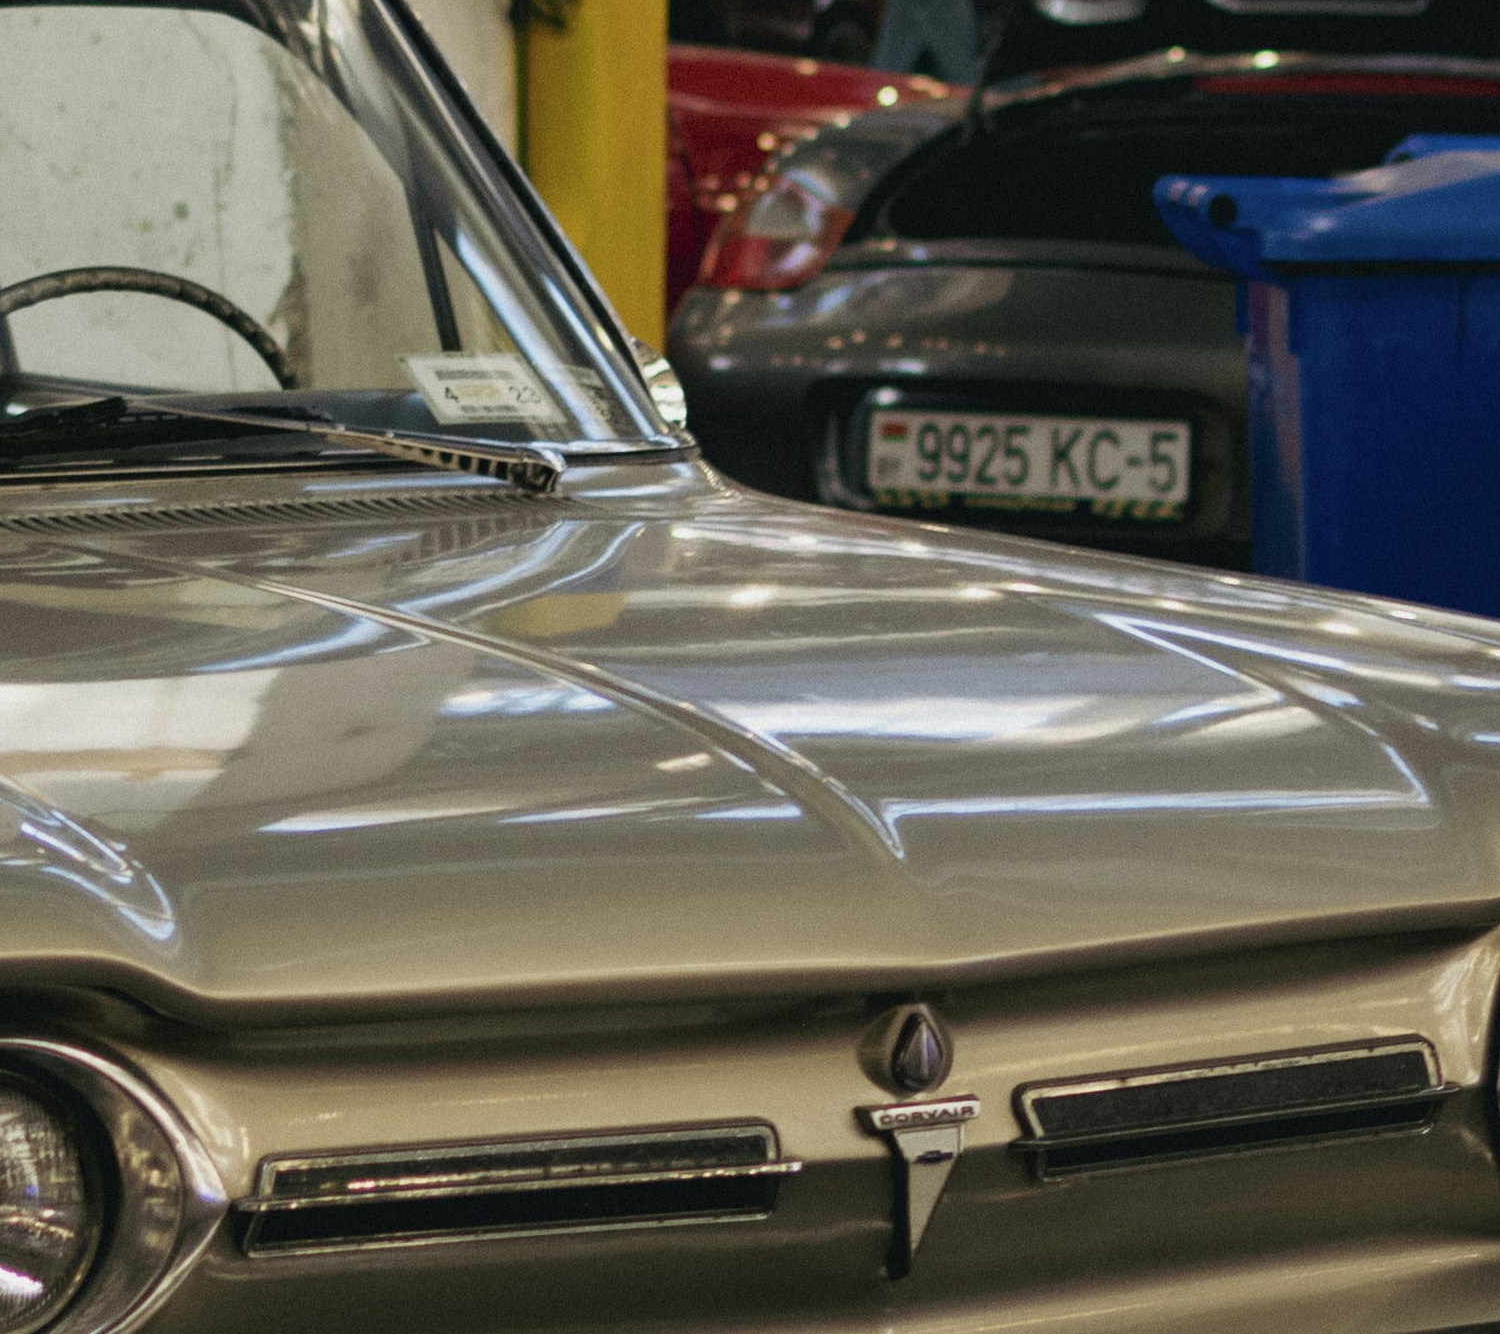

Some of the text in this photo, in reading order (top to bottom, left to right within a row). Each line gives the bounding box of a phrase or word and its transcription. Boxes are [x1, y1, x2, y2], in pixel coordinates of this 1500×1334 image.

[917, 423, 1178, 493] 9925 KC-5
[879, 1105, 975, 1126] CORVAIR
